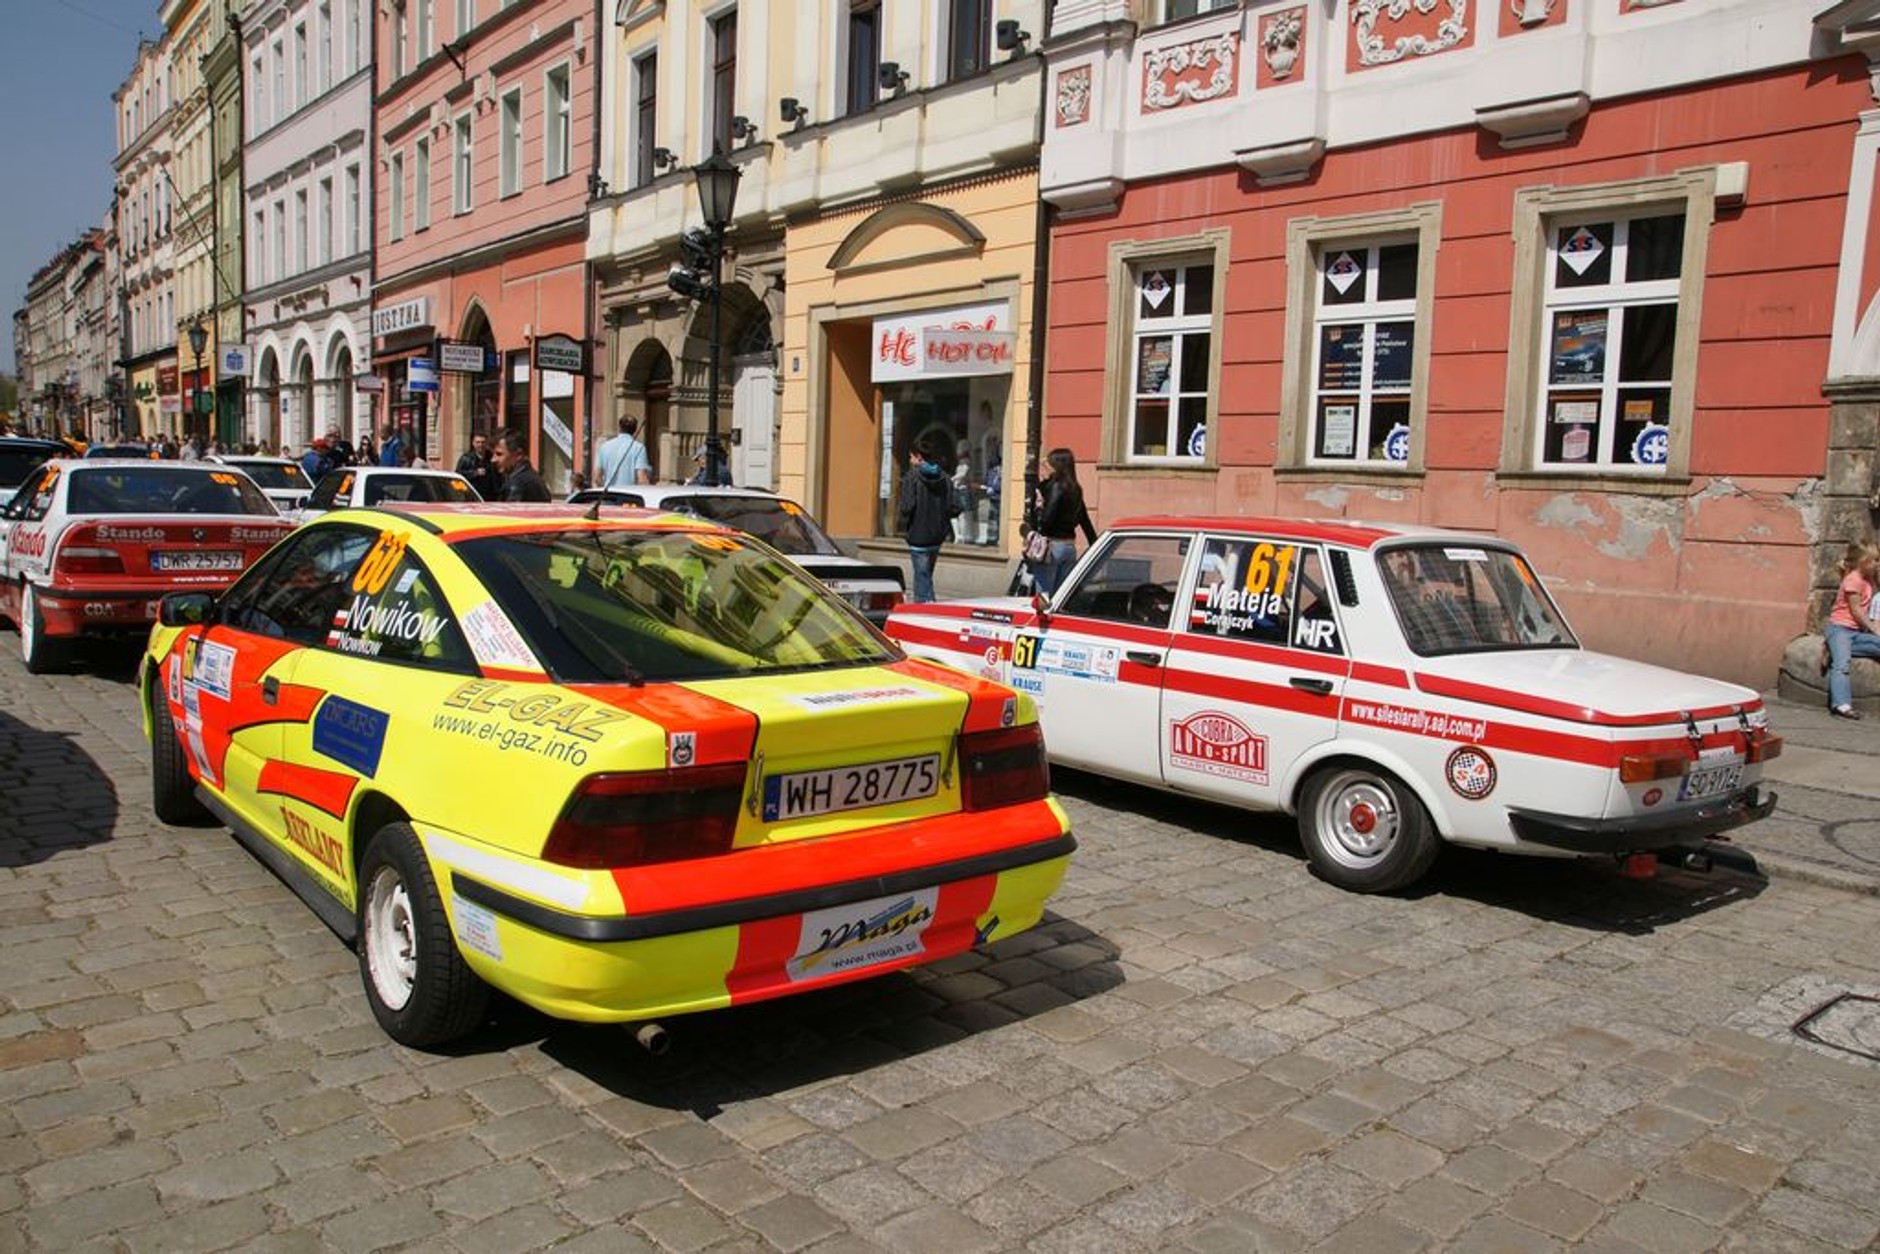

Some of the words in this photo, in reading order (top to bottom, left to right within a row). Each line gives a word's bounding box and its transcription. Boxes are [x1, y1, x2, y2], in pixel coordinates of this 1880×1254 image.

[96, 525, 166, 539] Stando
[161, 554, 191, 569] DWR
[195, 553, 240, 568] 25757
[1246, 542, 1295, 598] 61
[344, 595, 449, 642] Nowikow
[1206, 583, 1281, 619] Mateja
[1015, 635, 1036, 668] 61
[443, 679, 632, 743] EL-GAZ
[1200, 718, 1234, 743] COBRA
[432, 714, 588, 767] www.el-gaz.info
[1174, 727, 1263, 769] AUTO-SPORT
[786, 774, 834, 815] WH
[843, 760, 934, 807] 28775
